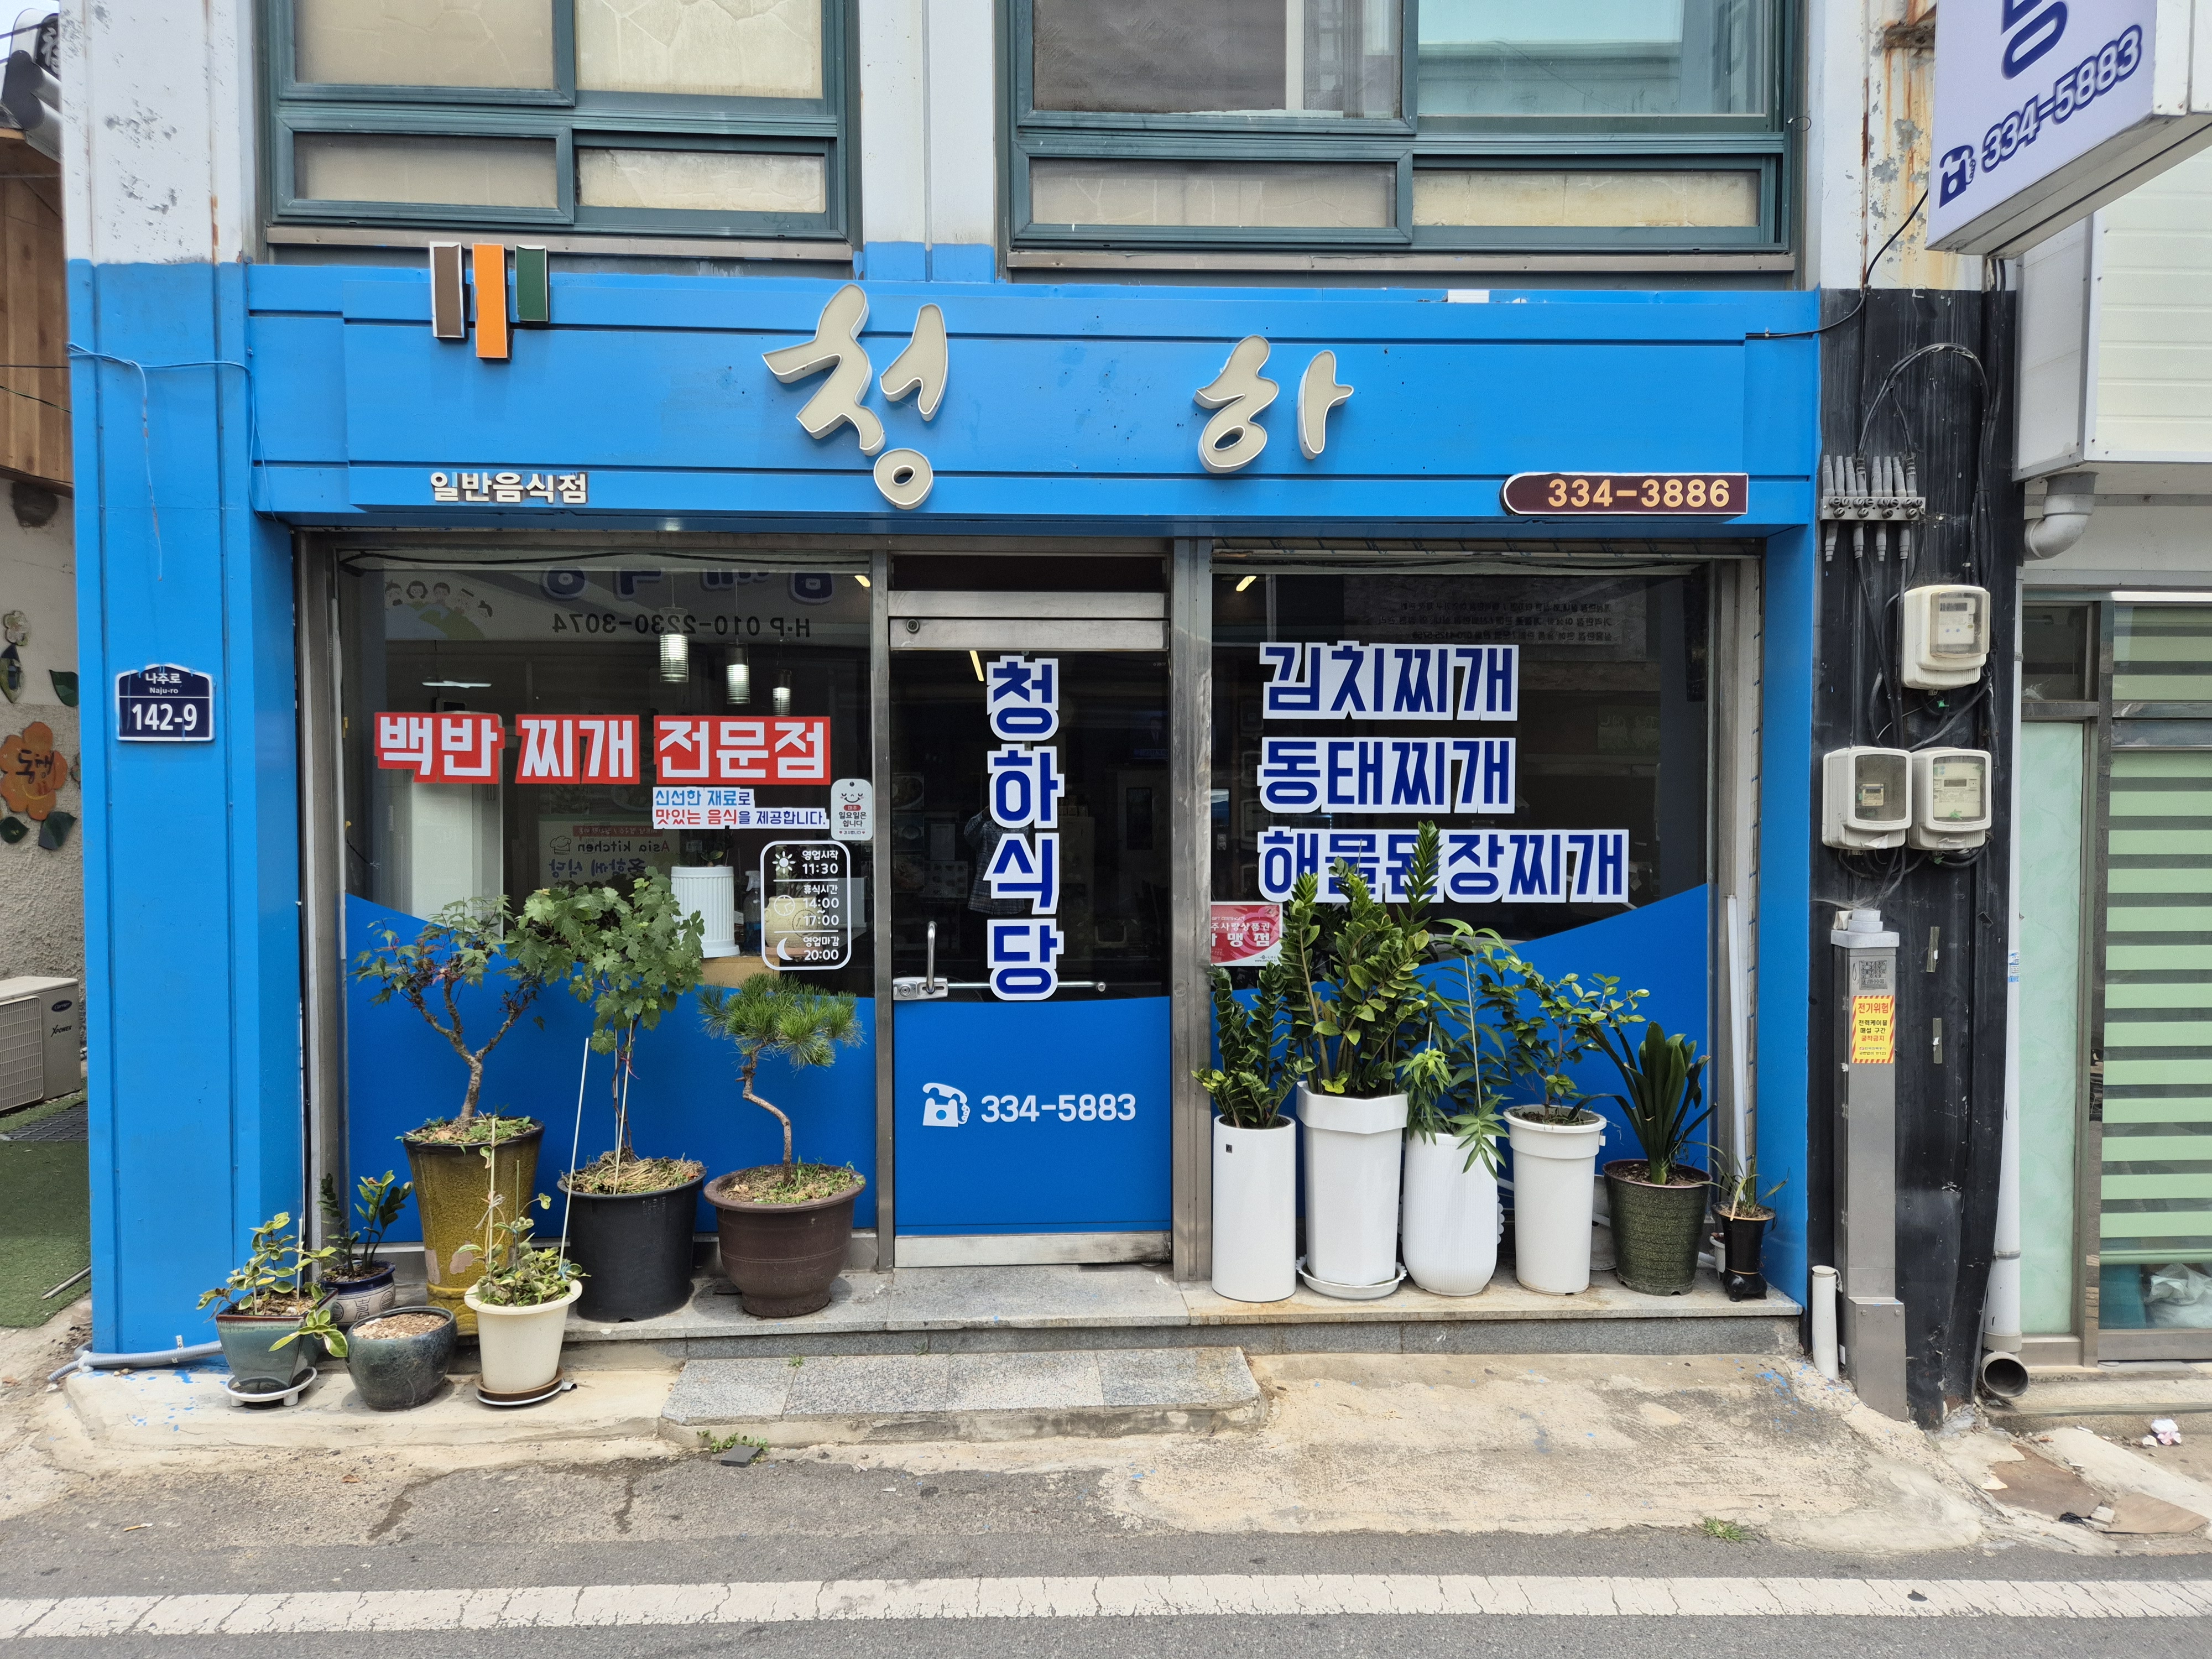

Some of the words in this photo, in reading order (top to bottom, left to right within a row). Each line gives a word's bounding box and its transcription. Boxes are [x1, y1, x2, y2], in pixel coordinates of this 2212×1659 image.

[1981, 24, 2143, 173] 334-5883
[430, 472, 587, 504] 일반음식점
[1548, 478, 1730, 509] 334-3886
[145, 672, 182, 685] 나주로
[1265, 645, 1512, 713] 김치찌개
[149, 687, 179, 695] Naju-ro
[132, 703, 197, 731] 142-9
[379, 716, 498, 776] 백반
[521, 719, 633, 778] 찌개
[659, 721, 825, 779] 전문점
[1263, 740, 1510, 806] 동태찌개
[655, 790, 701, 806] 신선한
[707, 790, 750, 806] 재료로
[655, 809, 701, 825] 맛있는
[707, 809, 750, 825] 음식을
[756, 811, 826, 825] 제공합니다.
[993, 660, 1060, 995] 청하식당
[802, 850, 838, 860] 영업시작
[802, 863, 838, 874] 11:30
[804, 884, 838, 895] 휴식시간
[803, 898, 839, 909] 14:00
[803, 915, 839, 926] 17:00
[803, 936, 839, 947] 영업마감
[804, 950, 839, 961] 20:00
[1858, 1003, 1888, 1014] 전기위험
[980, 1093, 1136, 1123] 334-5883
